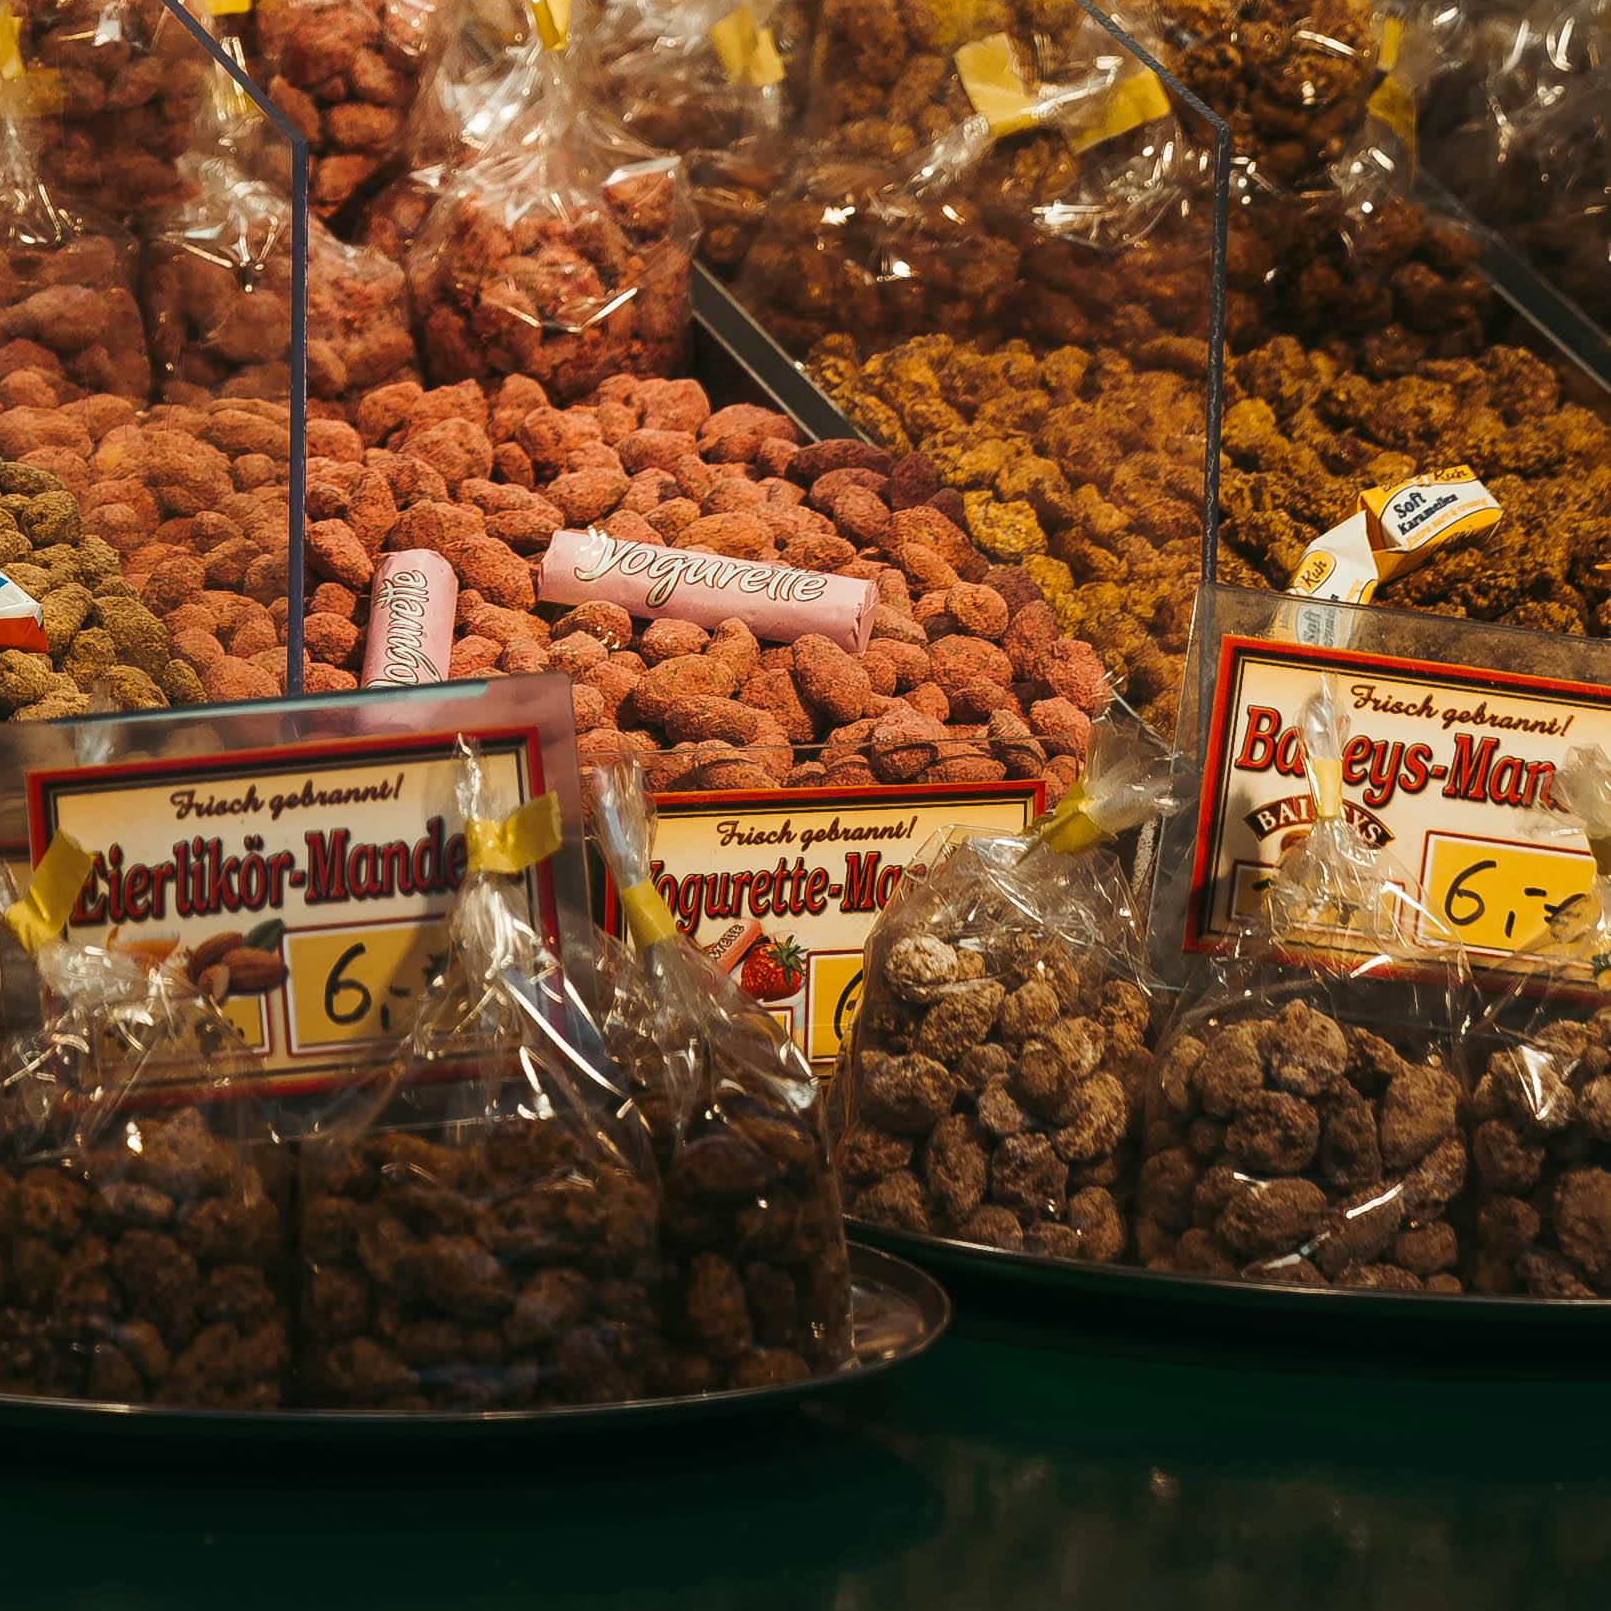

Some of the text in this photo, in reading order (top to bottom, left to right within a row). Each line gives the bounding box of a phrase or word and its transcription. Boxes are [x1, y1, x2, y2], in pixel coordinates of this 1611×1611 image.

[1393, 491, 1427, 520] Soft
[1350, 684, 1575, 738] Frisch gebrannt!
[168, 772, 406, 821] Frisch gebrannt!
[716, 815, 918, 855] Frisch gebrannt!
[69, 816, 468, 925] Eierlikör-Mande
